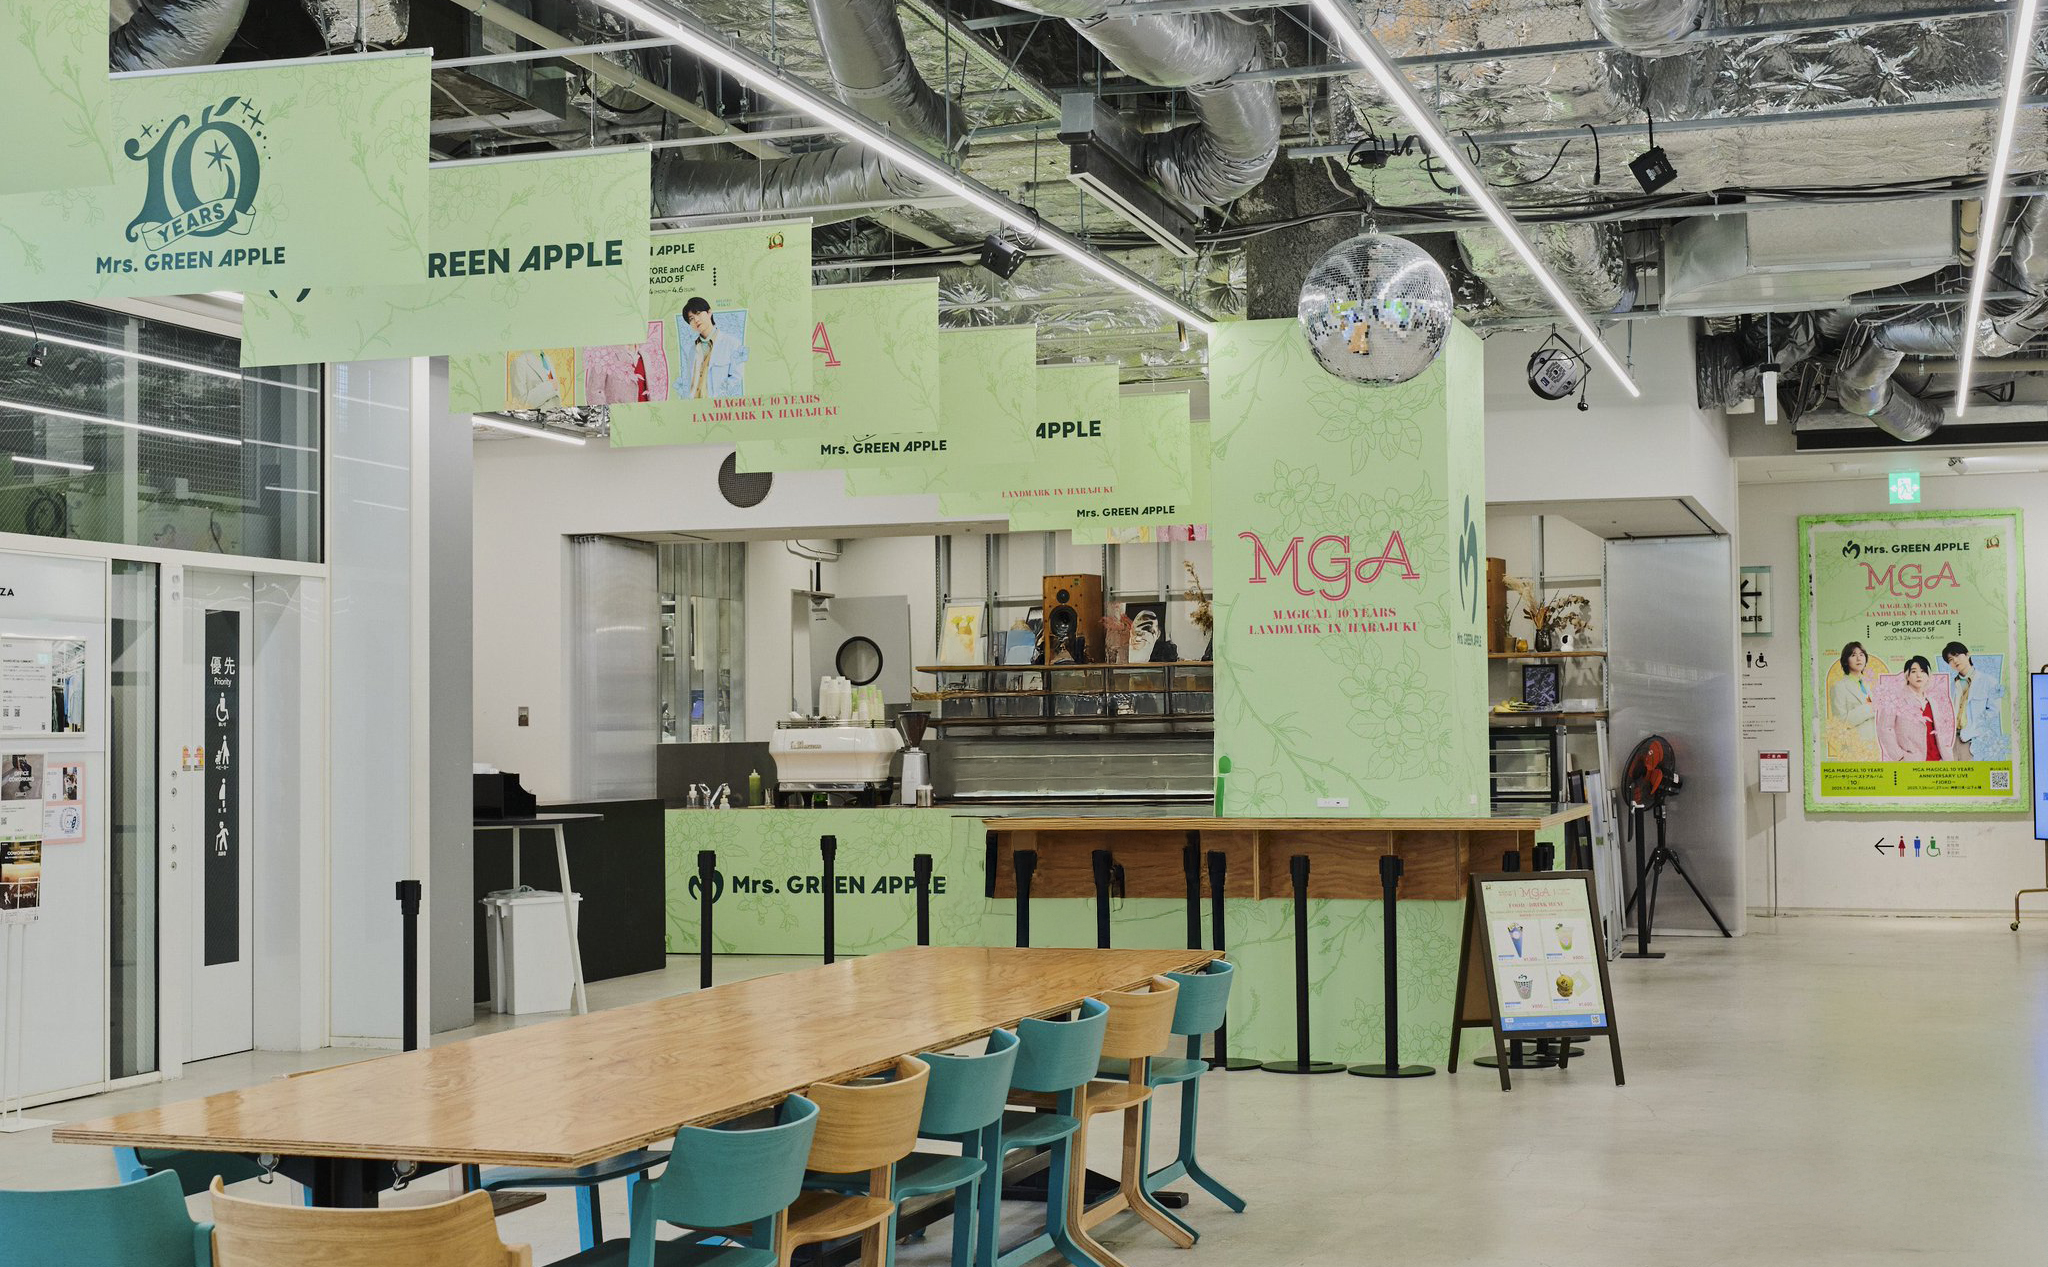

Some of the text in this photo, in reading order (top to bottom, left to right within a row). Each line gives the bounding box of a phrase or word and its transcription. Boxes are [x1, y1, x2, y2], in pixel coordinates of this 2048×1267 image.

[157, 203, 225, 243] YEARS
[518, 239, 623, 272] APPLE
[656, 243, 695, 256] APPLE
[96, 246, 285, 274] Mrs. GREEN APPLE
[669, 265, 684, 274] and
[685, 264, 705, 272] CAFE
[674, 275, 685, 283] 5F
[713, 394, 821, 408] MAGICAL 10 YEARS
[692, 406, 841, 423] LANDMARK IN HARAJUKU
[1035, 420, 1101, 439] APPLE
[820, 440, 947, 455] Mrs. GREEN APPLE
[1001, 486, 1115, 498] LANDMARK IN HARAJUKU
[1076, 505, 1175, 518] Mrs. GREEN APPLE
[1864, 542, 1970, 554] Mrs. GREEN APPLE
[1238, 530, 1420, 601] MGA
[1859, 561, 1961, 599] MGA
[1273, 607, 1397, 620] MAGICAL 10 YEARS
[1249, 621, 1420, 635] LANDMARK IN HARAJUKU
[210, 656, 236, 675] 優先
[214, 677, 232, 687] Priority
[732, 875, 946, 894] Mrs. GREN APPE
